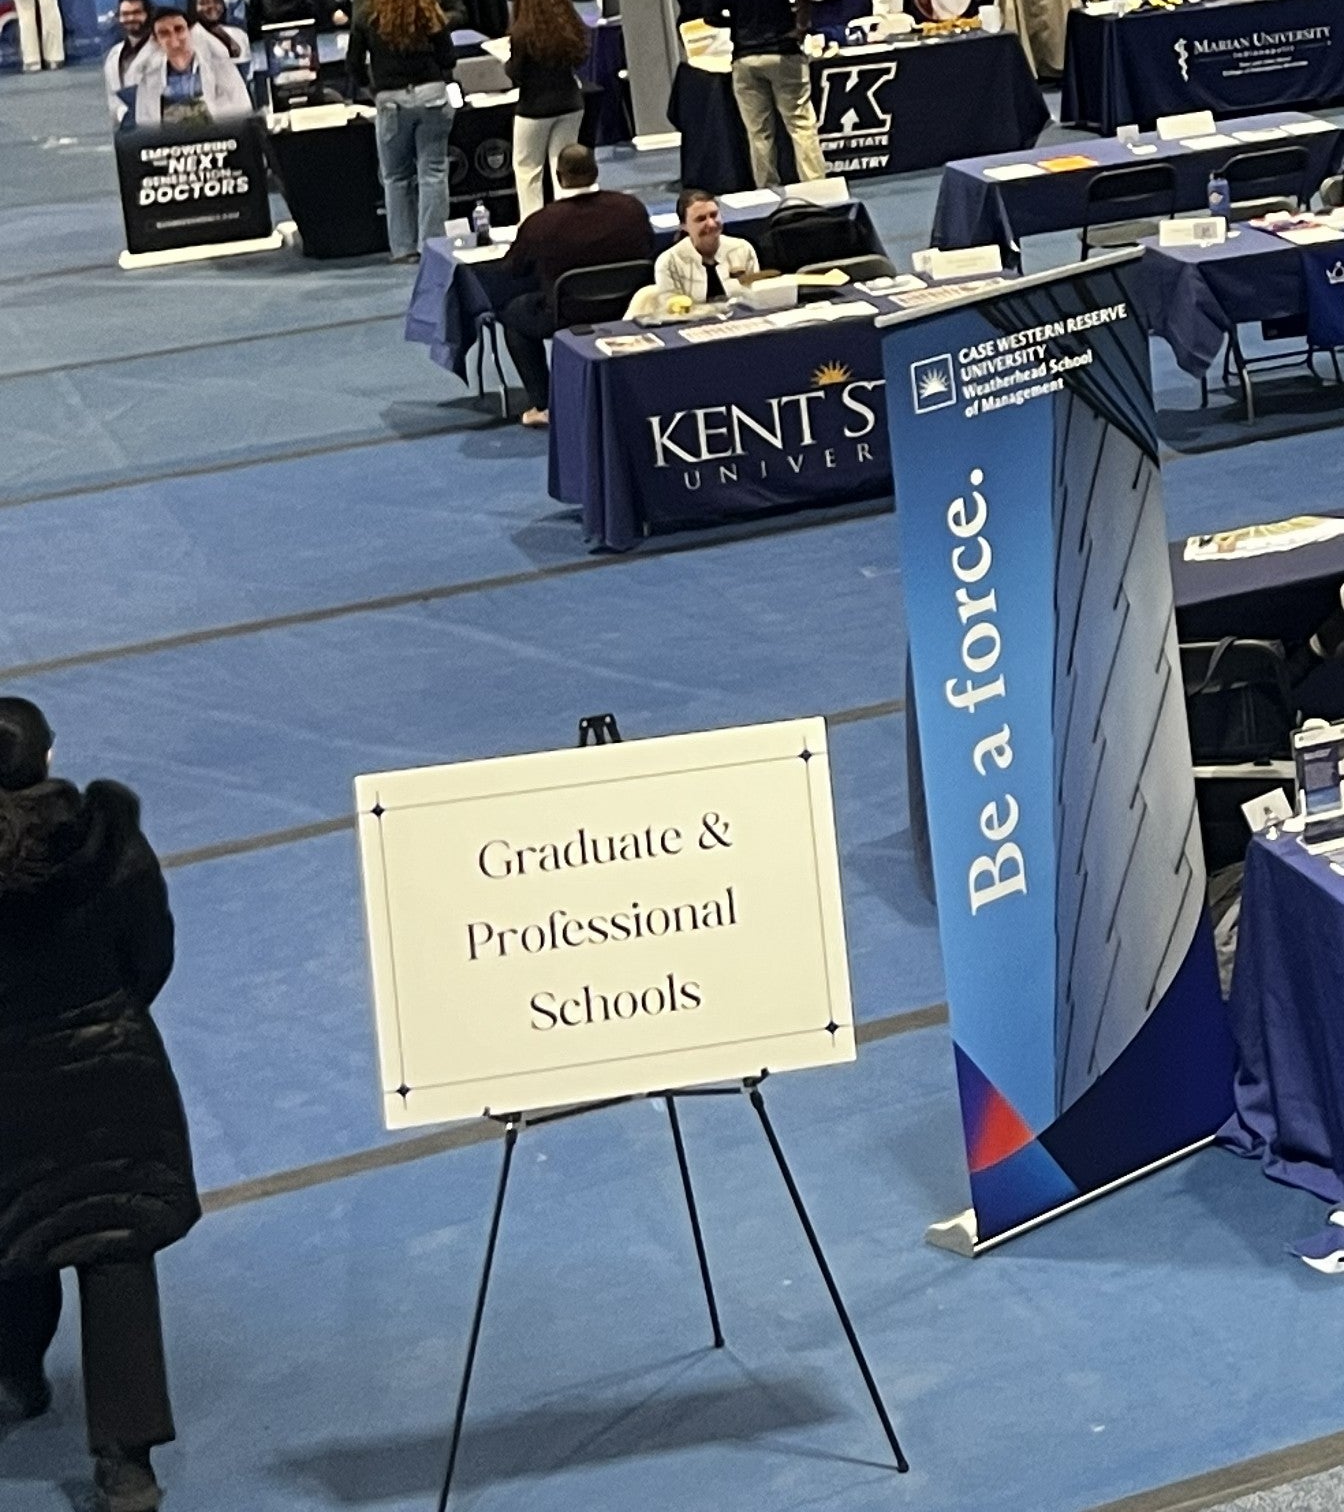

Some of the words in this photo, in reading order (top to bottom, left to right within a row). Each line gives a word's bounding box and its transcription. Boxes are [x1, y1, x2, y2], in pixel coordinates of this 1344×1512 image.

[1193, 37, 1250, 55] MARIAN
[1253, 26, 1331, 47] UNIVERSITY
[817, 60, 898, 139] K
[168, 151, 228, 174] NEXT
[820, 139, 845, 152] ENT
[851, 135, 889, 149] STATE
[139, 176, 249, 206] DOCTORS
[958, 337, 996, 365] CASE
[997, 321, 1065, 352] WESTERN
[1066, 303, 1128, 333] RESERVE
[960, 344, 1047, 382] UNIVERSITY
[962, 364, 1048, 400] Weatherhead
[1050, 349, 1094, 375] School
[964, 399, 979, 419] of
[981, 378, 1064, 414] Management
[647, 390, 826, 469] KENT
[684, 442, 875, 492] UNIVER
[945, 468, 1007, 714] force.
[973, 723, 1015, 777] a
[477, 820, 684, 881] Graduate
[697, 810, 735, 851] &
[969, 793, 1028, 917] Be
[465, 886, 740, 962] Professional
[528, 972, 702, 1032] Schools
